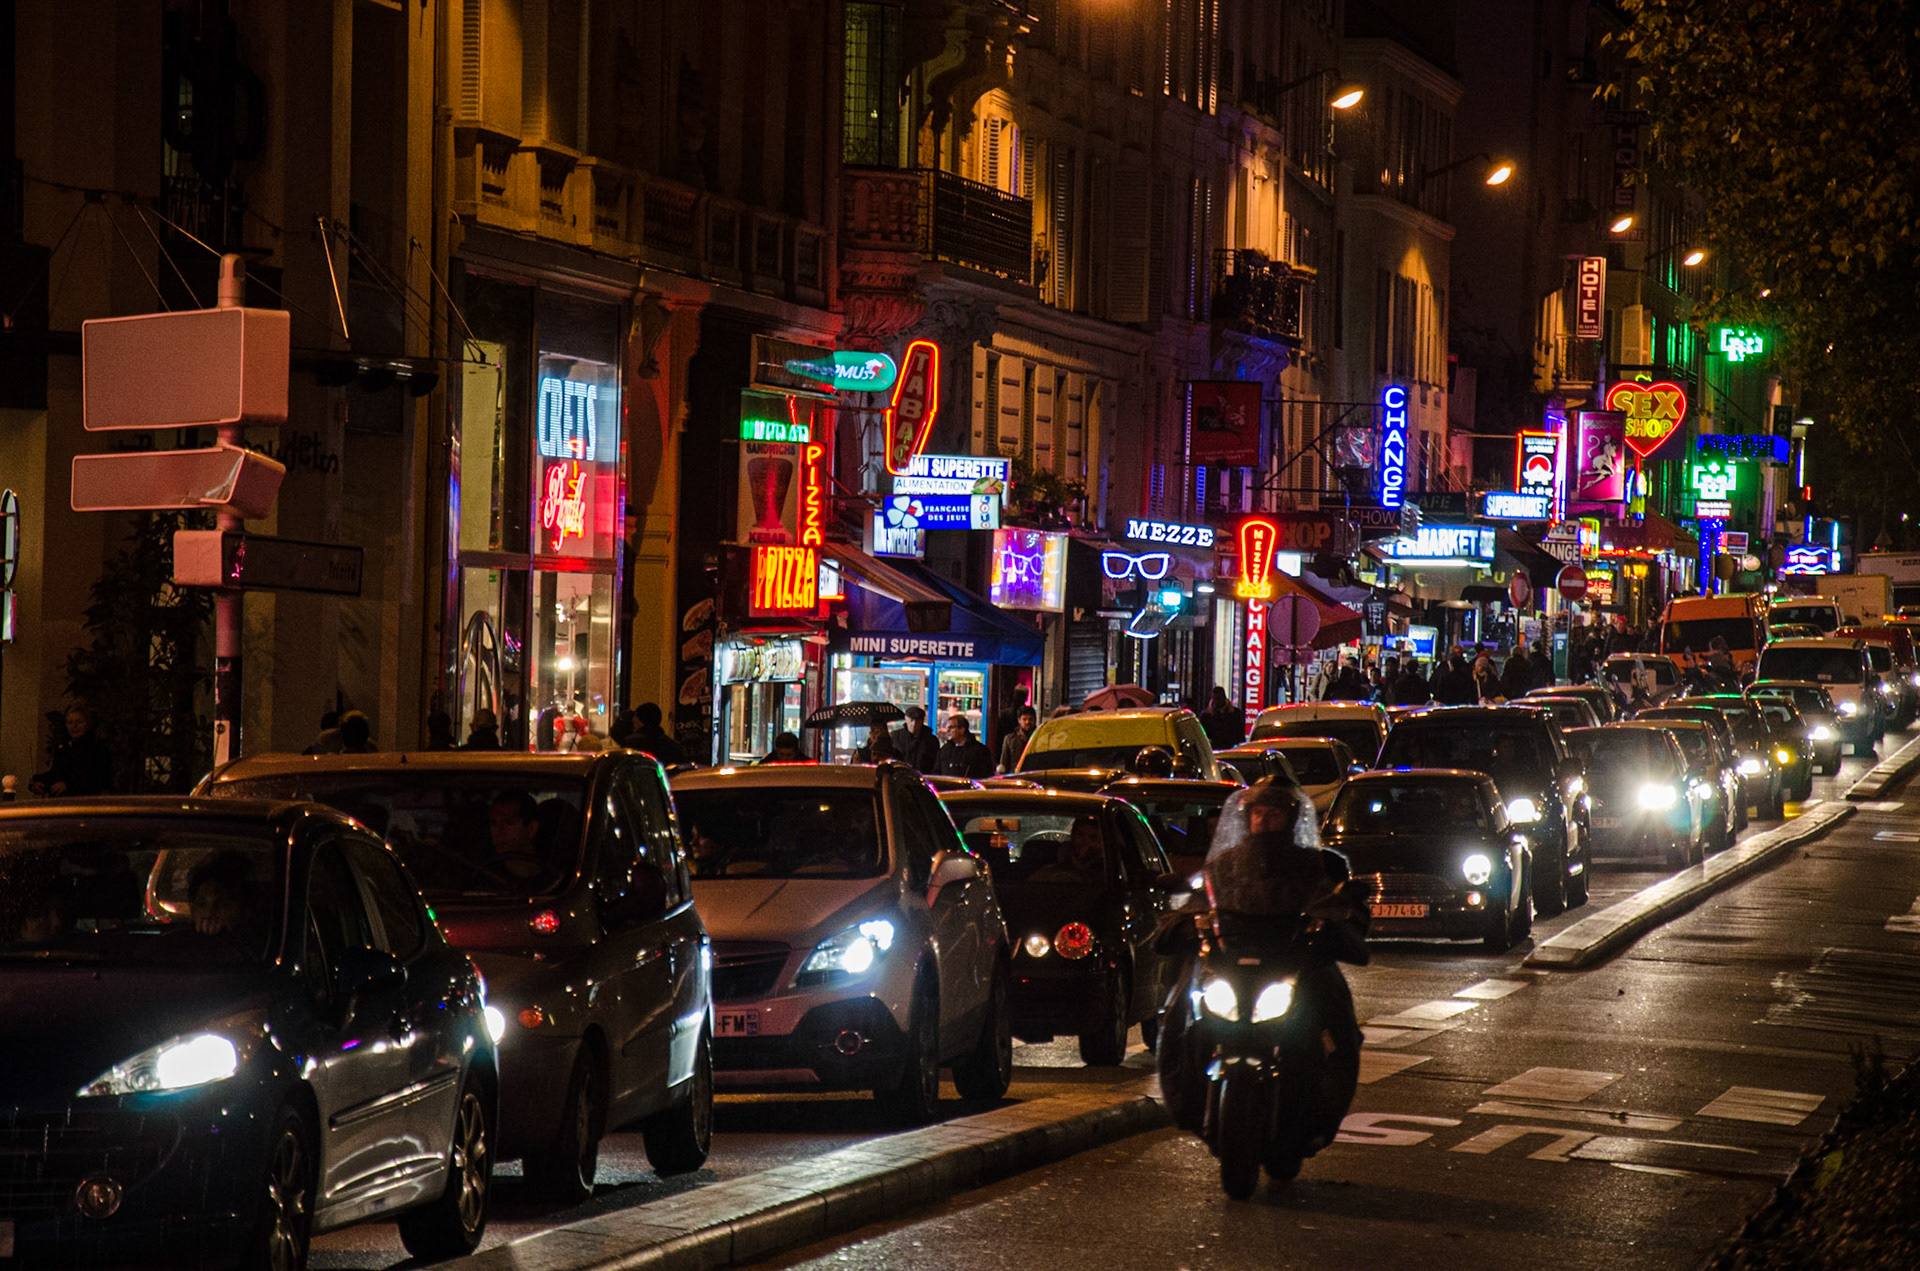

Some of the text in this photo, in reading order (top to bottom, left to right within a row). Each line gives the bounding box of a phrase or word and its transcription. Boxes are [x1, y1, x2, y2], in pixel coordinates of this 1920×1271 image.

[1582, 261, 1599, 323] HOTEL
[893, 352, 930, 464] TABAC
[1612, 390, 1681, 419] SEX
[1625, 418, 1673, 438] SHOP
[1383, 387, 1406, 507] CHANGE
[931, 457, 1004, 479] SUPERETTE
[803, 445, 823, 546] PIZZA
[896, 479, 967, 490] ALIMENTATION
[946, 514, 967, 522] JEUX
[1486, 495, 1549, 518] SUPERMARKET
[1127, 519, 1214, 547] MEZZE
[850, 637, 974, 658] MINI SUPERETTE
[1245, 597, 1263, 704] CHANGE
